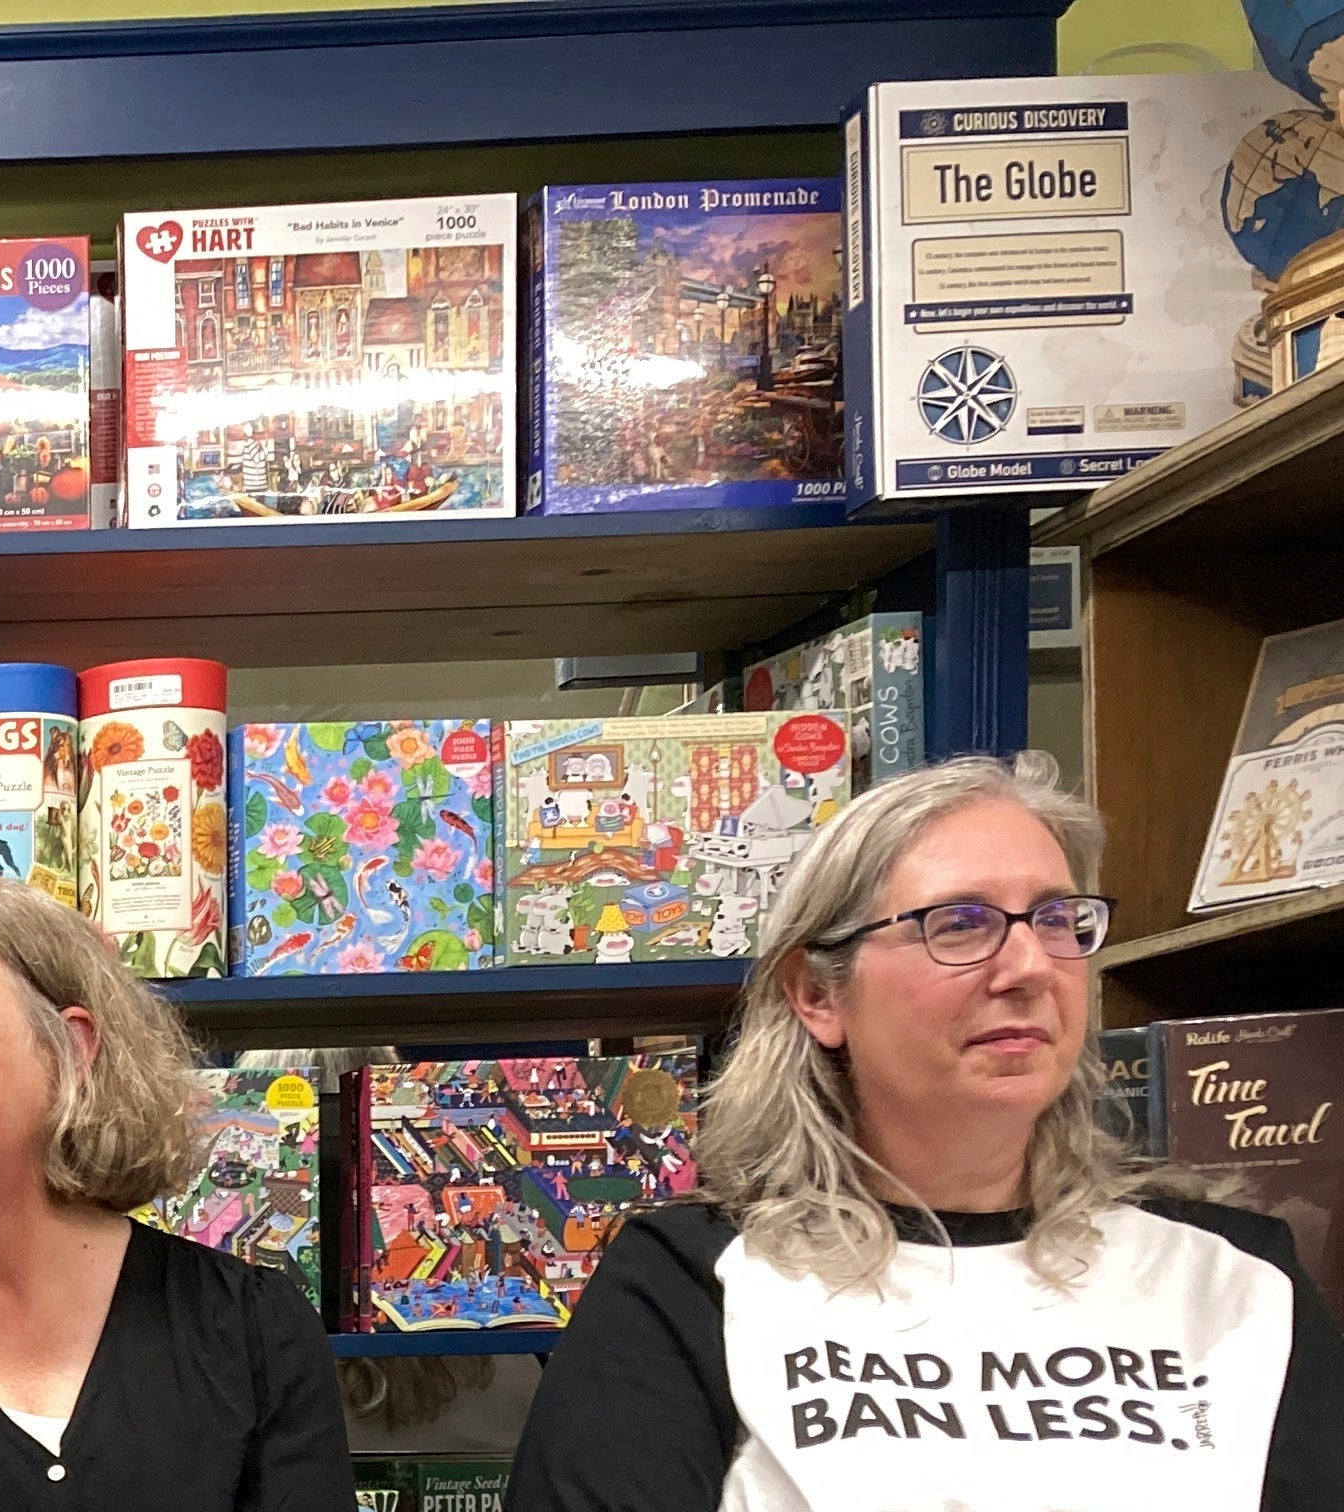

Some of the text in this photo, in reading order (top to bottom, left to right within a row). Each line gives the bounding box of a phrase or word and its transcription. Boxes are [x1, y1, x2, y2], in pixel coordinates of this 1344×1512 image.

[953, 108, 1106, 132] CURIOUS DISCOVERY
[934, 159, 1097, 204] The Globe
[609, 187, 820, 212] London Promenade
[192, 218, 254, 227] PUZZLES WITH
[316, 218, 361, 230] Habits in
[436, 215, 477, 230] 1000
[192, 228, 255, 253] HART
[425, 229, 487, 242] piece puzzle
[24, 257, 75, 281] 1000
[28, 280, 71, 295] Pieces
[947, 462, 1032, 479] Globe Model
[1079, 458, 1124, 472] Secret
[878, 686, 899, 764] COWS
[1264, 749, 1317, 771] FERRIS
[6, 821, 30, 832] dog!
[494, 768, 504, 897] HIDDEN COWS
[656, 903, 685, 919] TOYS
[1186, 1031, 1231, 1046] Rolife
[1188, 1060, 1268, 1107] Time
[1225, 1102, 1333, 1151] Travel
[784, 1340, 1209, 1391] READ MORE.
[791, 1391, 1190, 1450] BAN LESS.
[425, 1474, 501, 1494] Vintage Seed
